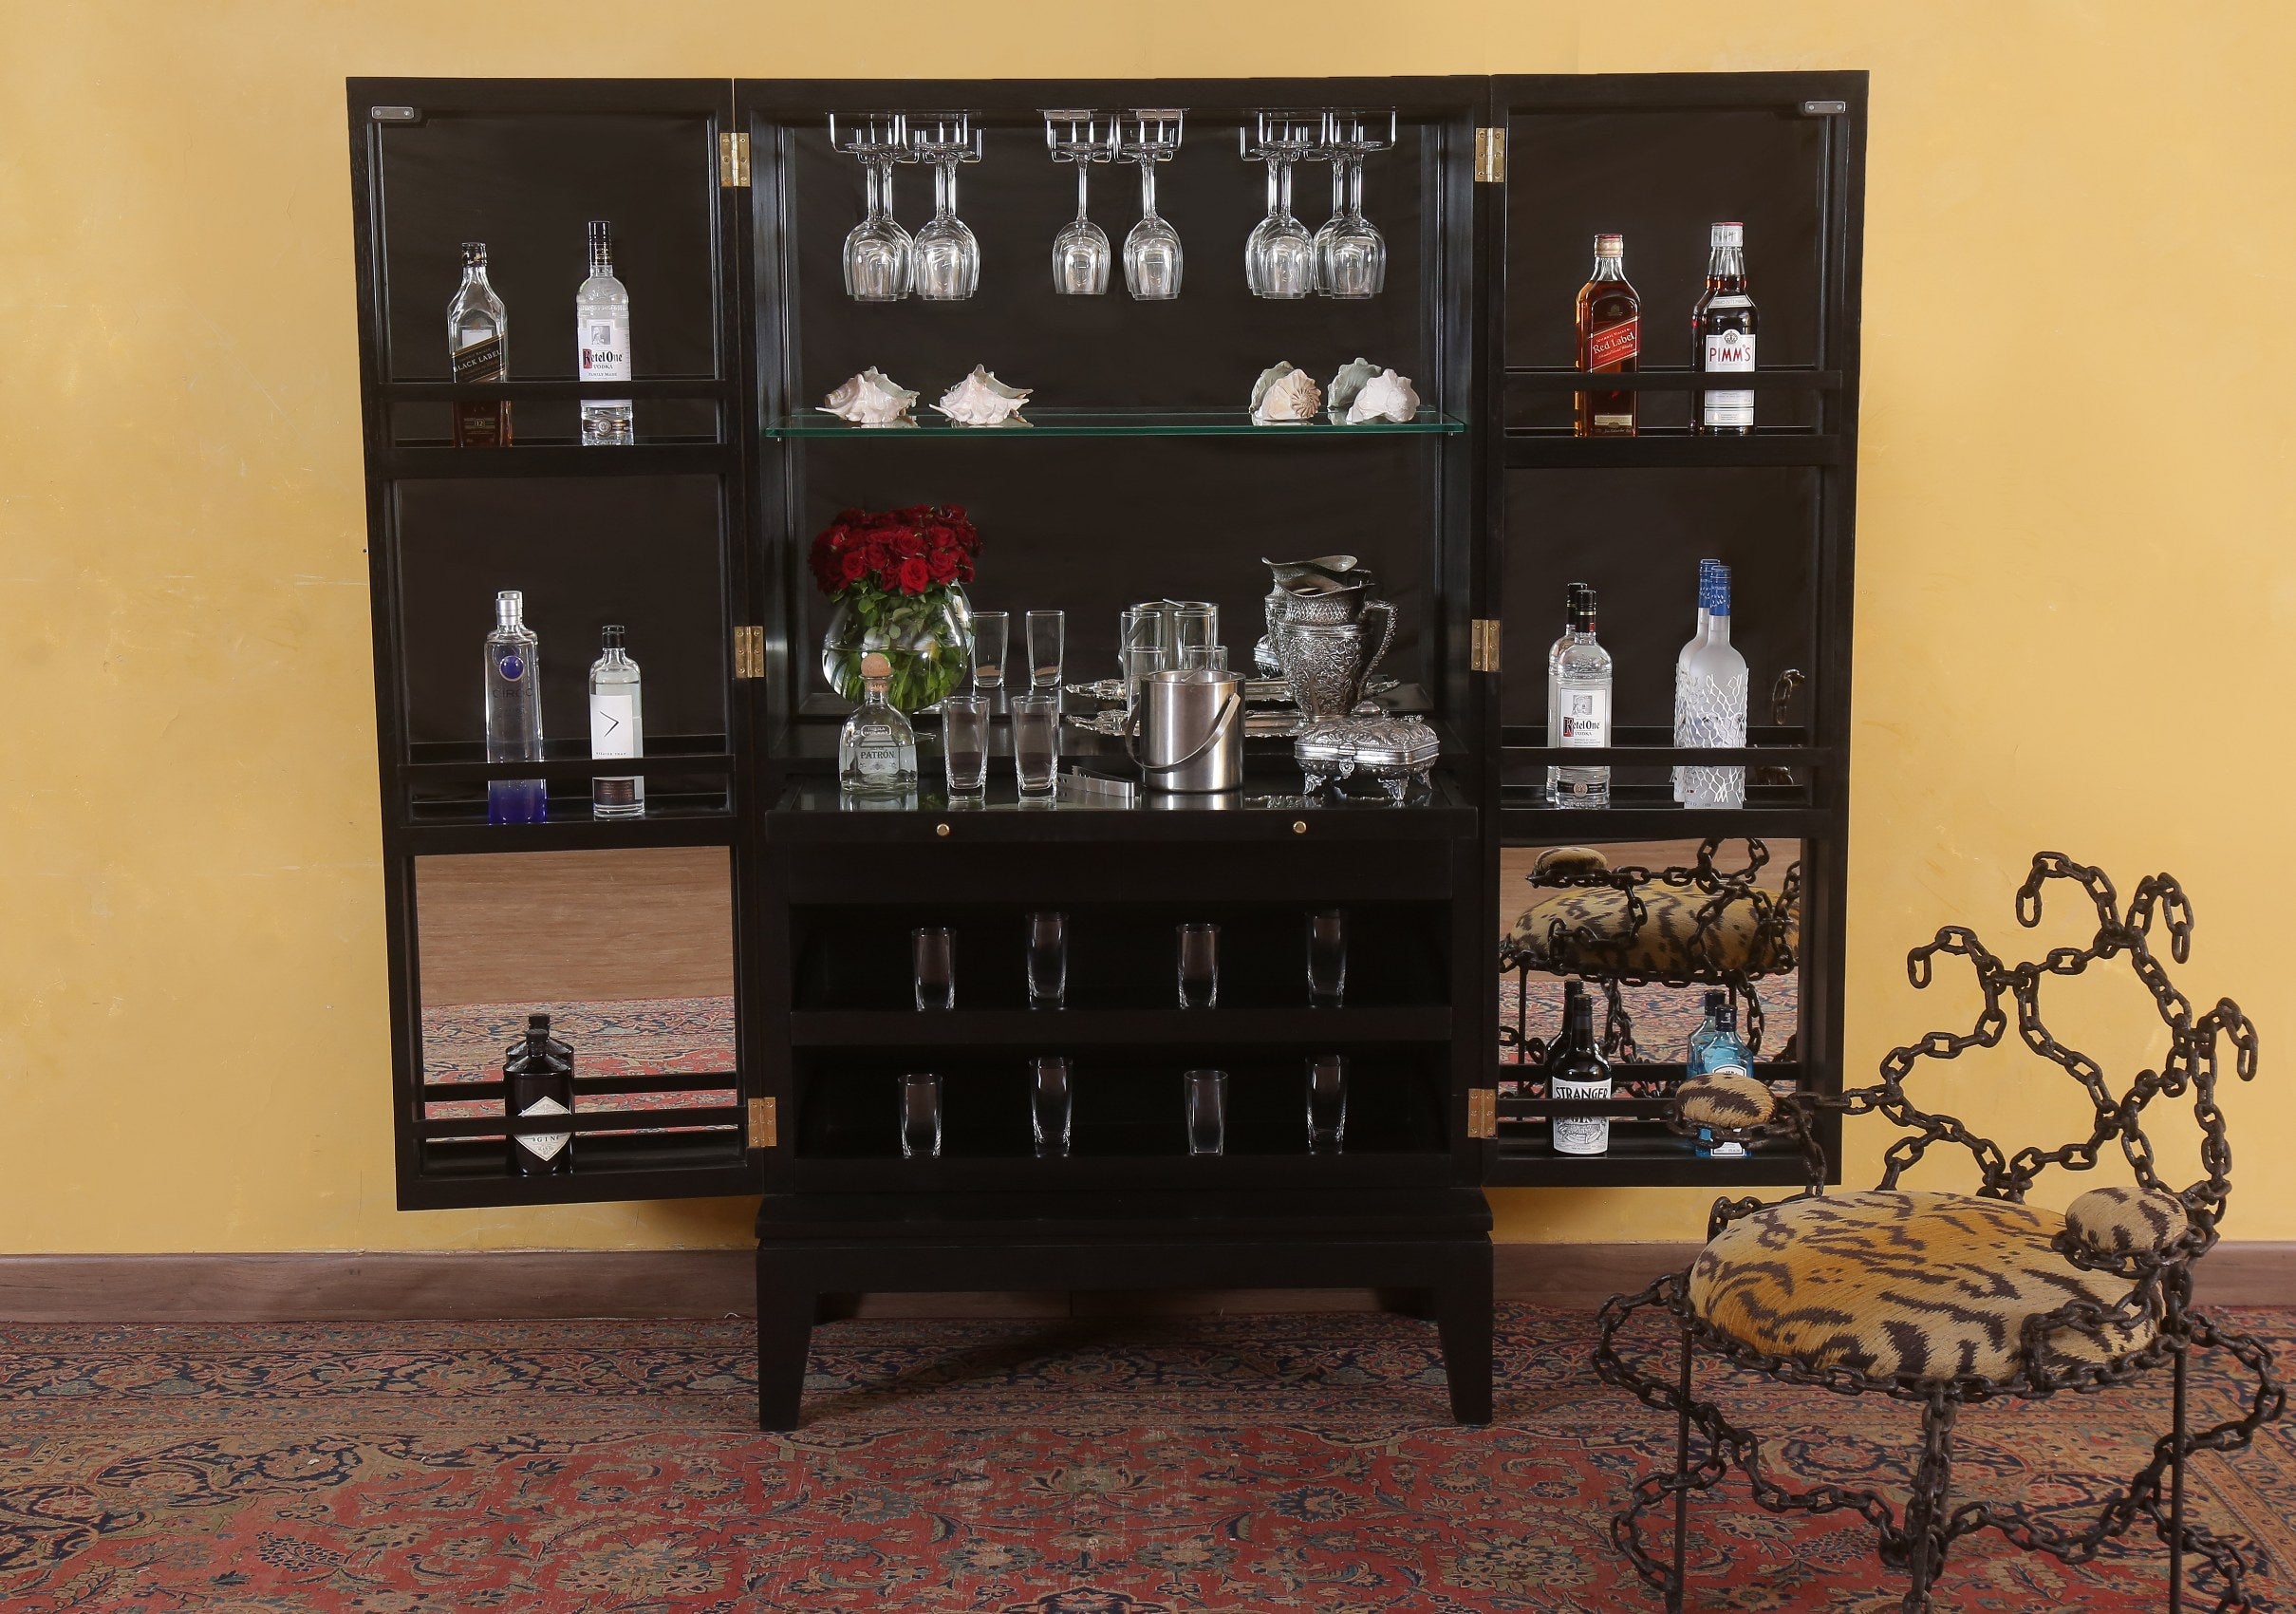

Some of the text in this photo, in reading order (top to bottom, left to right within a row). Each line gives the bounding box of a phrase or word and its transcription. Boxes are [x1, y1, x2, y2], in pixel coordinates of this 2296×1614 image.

[1593, 341, 1611, 354] Red
[1612, 331, 1635, 347] Label
[453, 359, 477, 372] BLACK
[478, 349, 501, 363] LABEL
[583, 348, 623, 368] Ketel One
[1709, 346, 1751, 362] PIMM'S
[1563, 716, 1600, 737] Ketel One
[860, 749, 895, 760] PATRÓN
[1556, 1087, 1608, 1099] STRANGER
